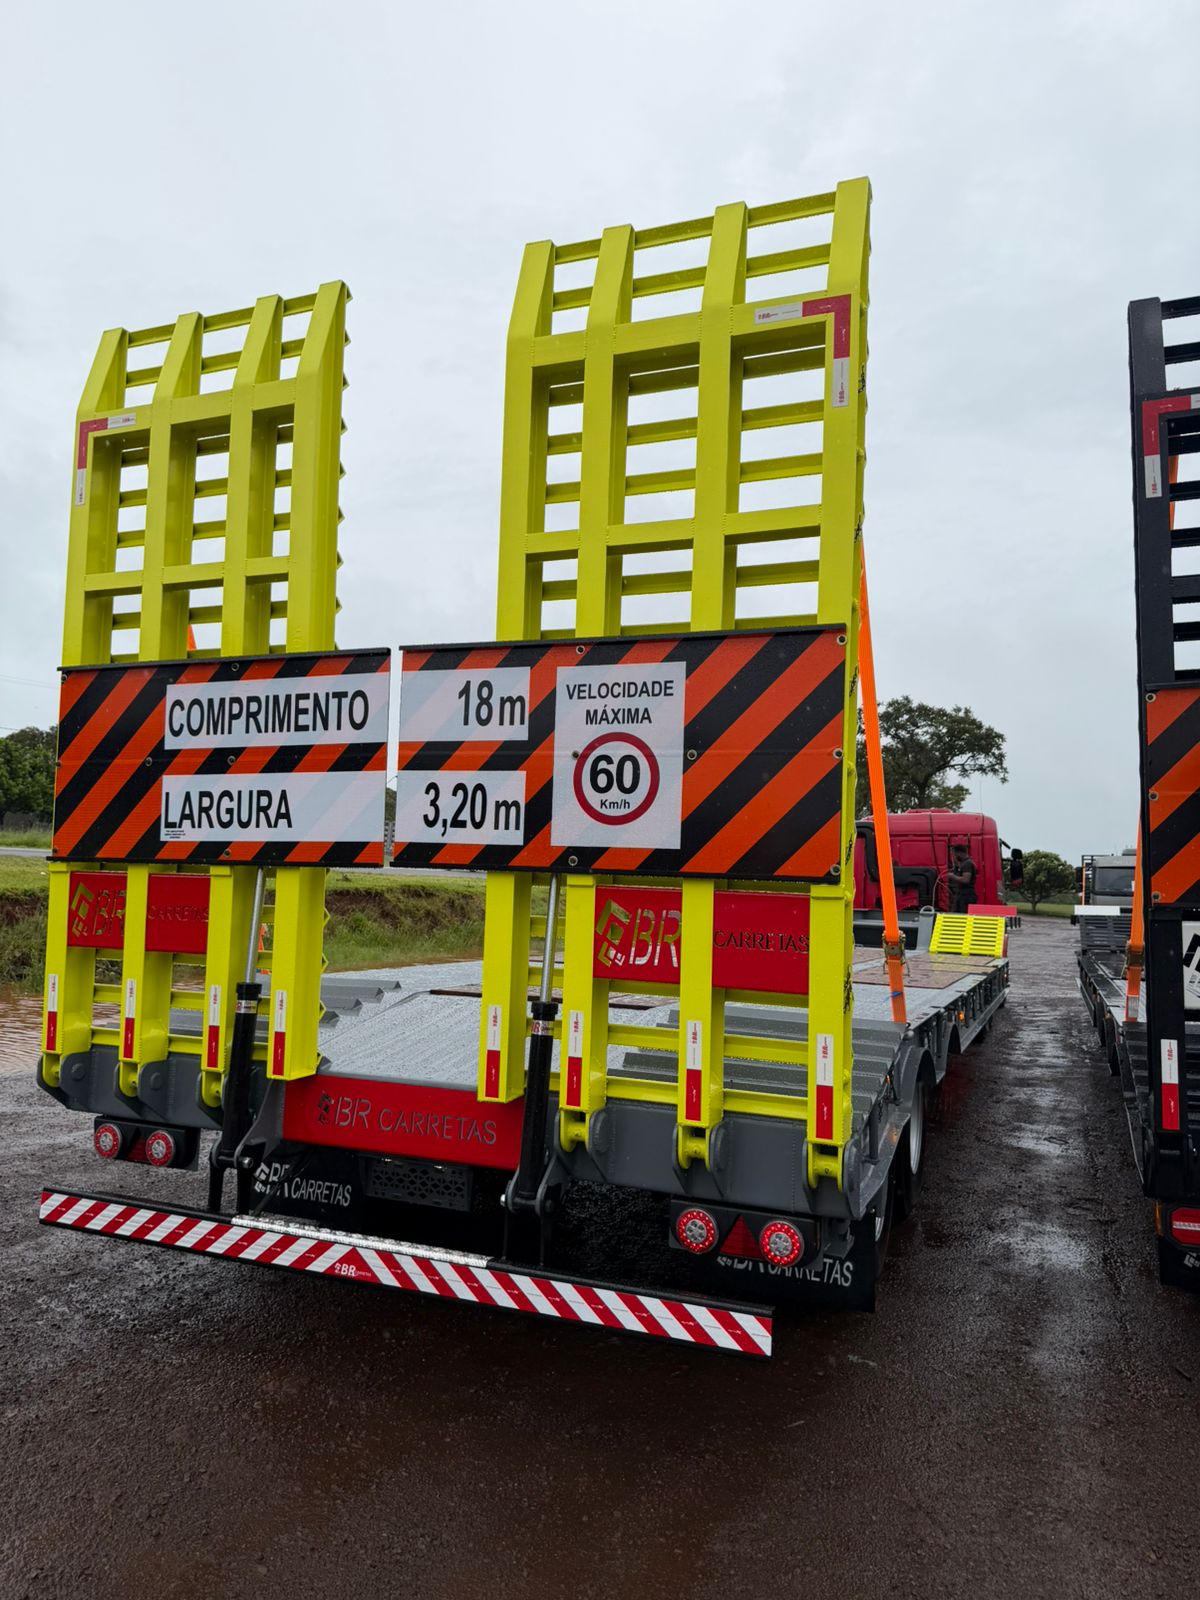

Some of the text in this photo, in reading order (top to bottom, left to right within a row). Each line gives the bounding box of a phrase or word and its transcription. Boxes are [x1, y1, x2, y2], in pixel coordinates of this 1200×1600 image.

[566, 680, 674, 700] VELOCIDADE
[168, 689, 369, 738] COMPRIMENTO
[585, 704, 653, 725] MÁXIMA
[589, 754, 641, 795] 60
[163, 789, 293, 829] LARGURA
[599, 799, 631, 811] Km/h
[628, 907, 810, 968] BR CARRETAS
[335, 1096, 497, 1145] BR CARRETAS
[291, 1177, 352, 1207] CARRETAS
[340, 1263, 356, 1276] BR
